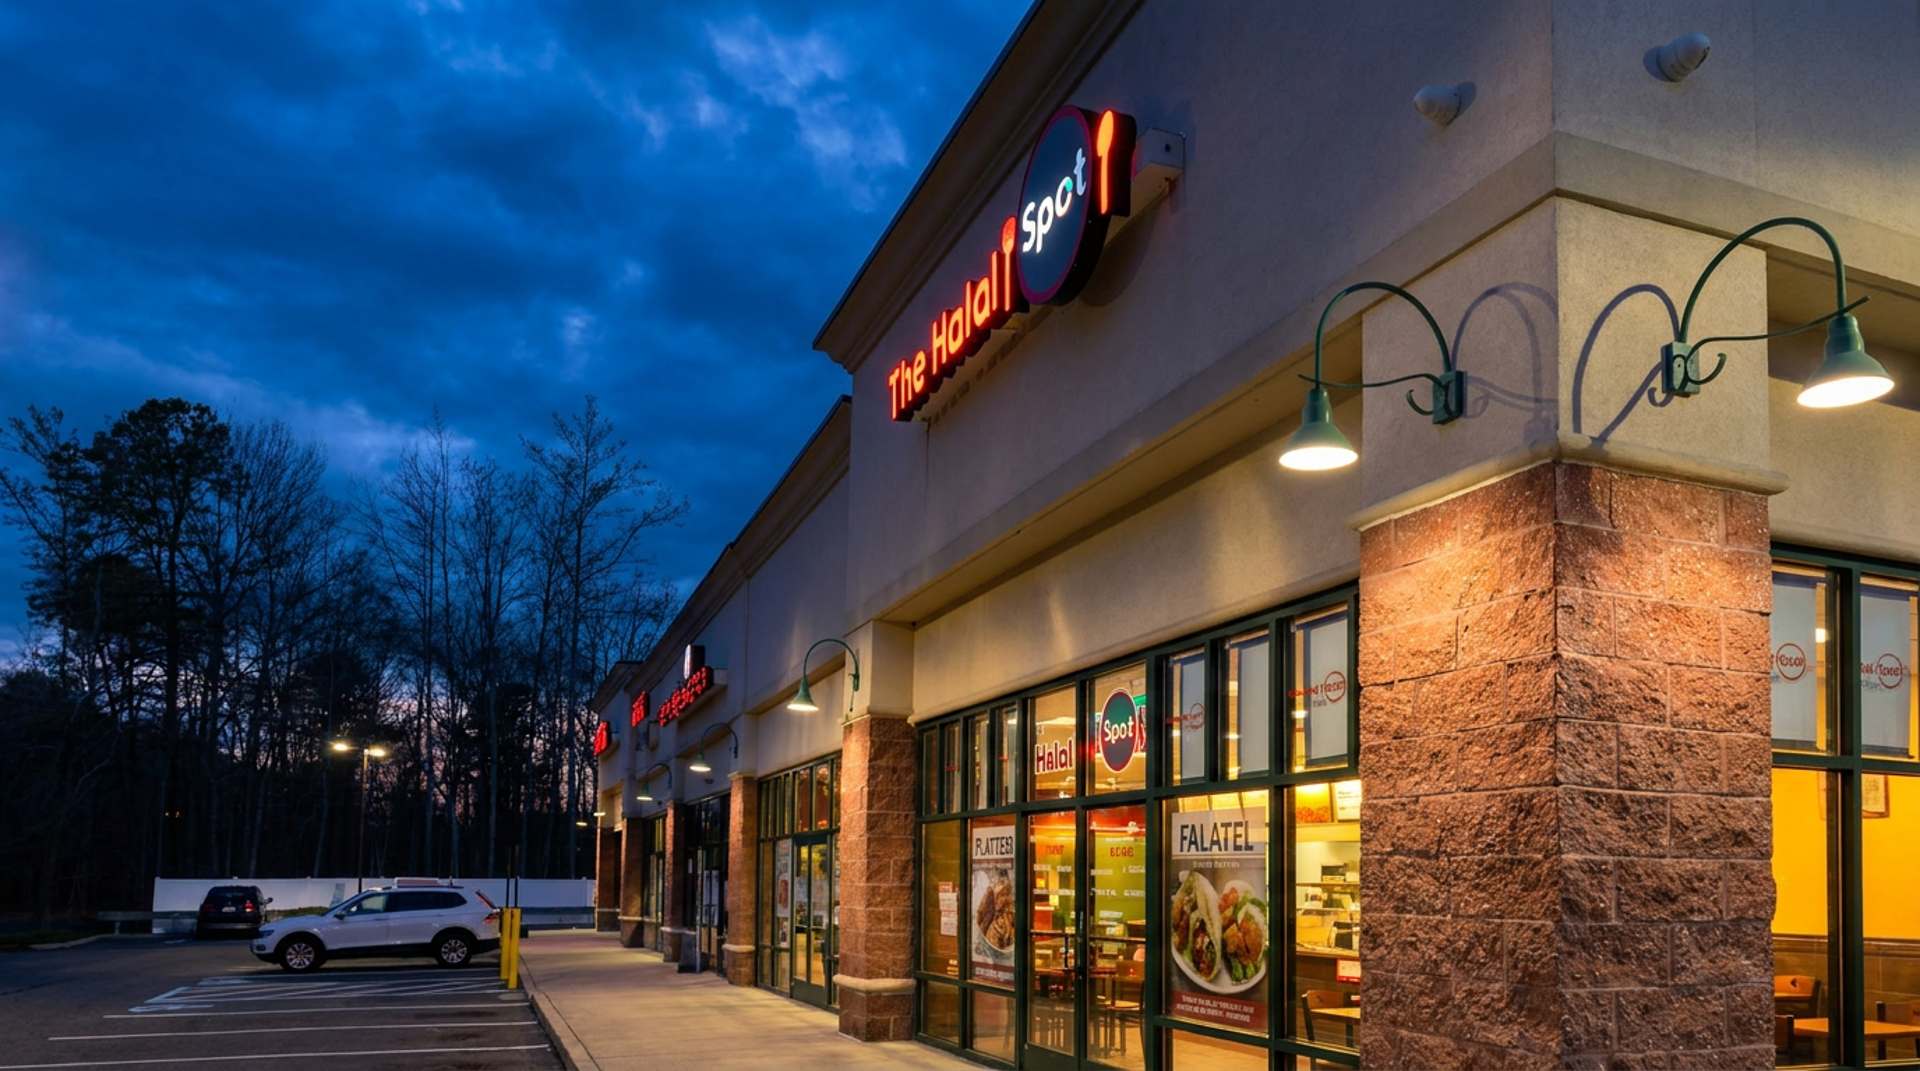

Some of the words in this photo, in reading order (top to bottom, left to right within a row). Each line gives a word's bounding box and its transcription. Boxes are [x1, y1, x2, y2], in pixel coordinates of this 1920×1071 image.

[888, 350, 926, 421] The
[931, 251, 999, 375] Halal
[1021, 147, 1087, 254] Spot
[1103, 716, 1134, 744] Spot
[1179, 820, 1254, 853] FALATEL
